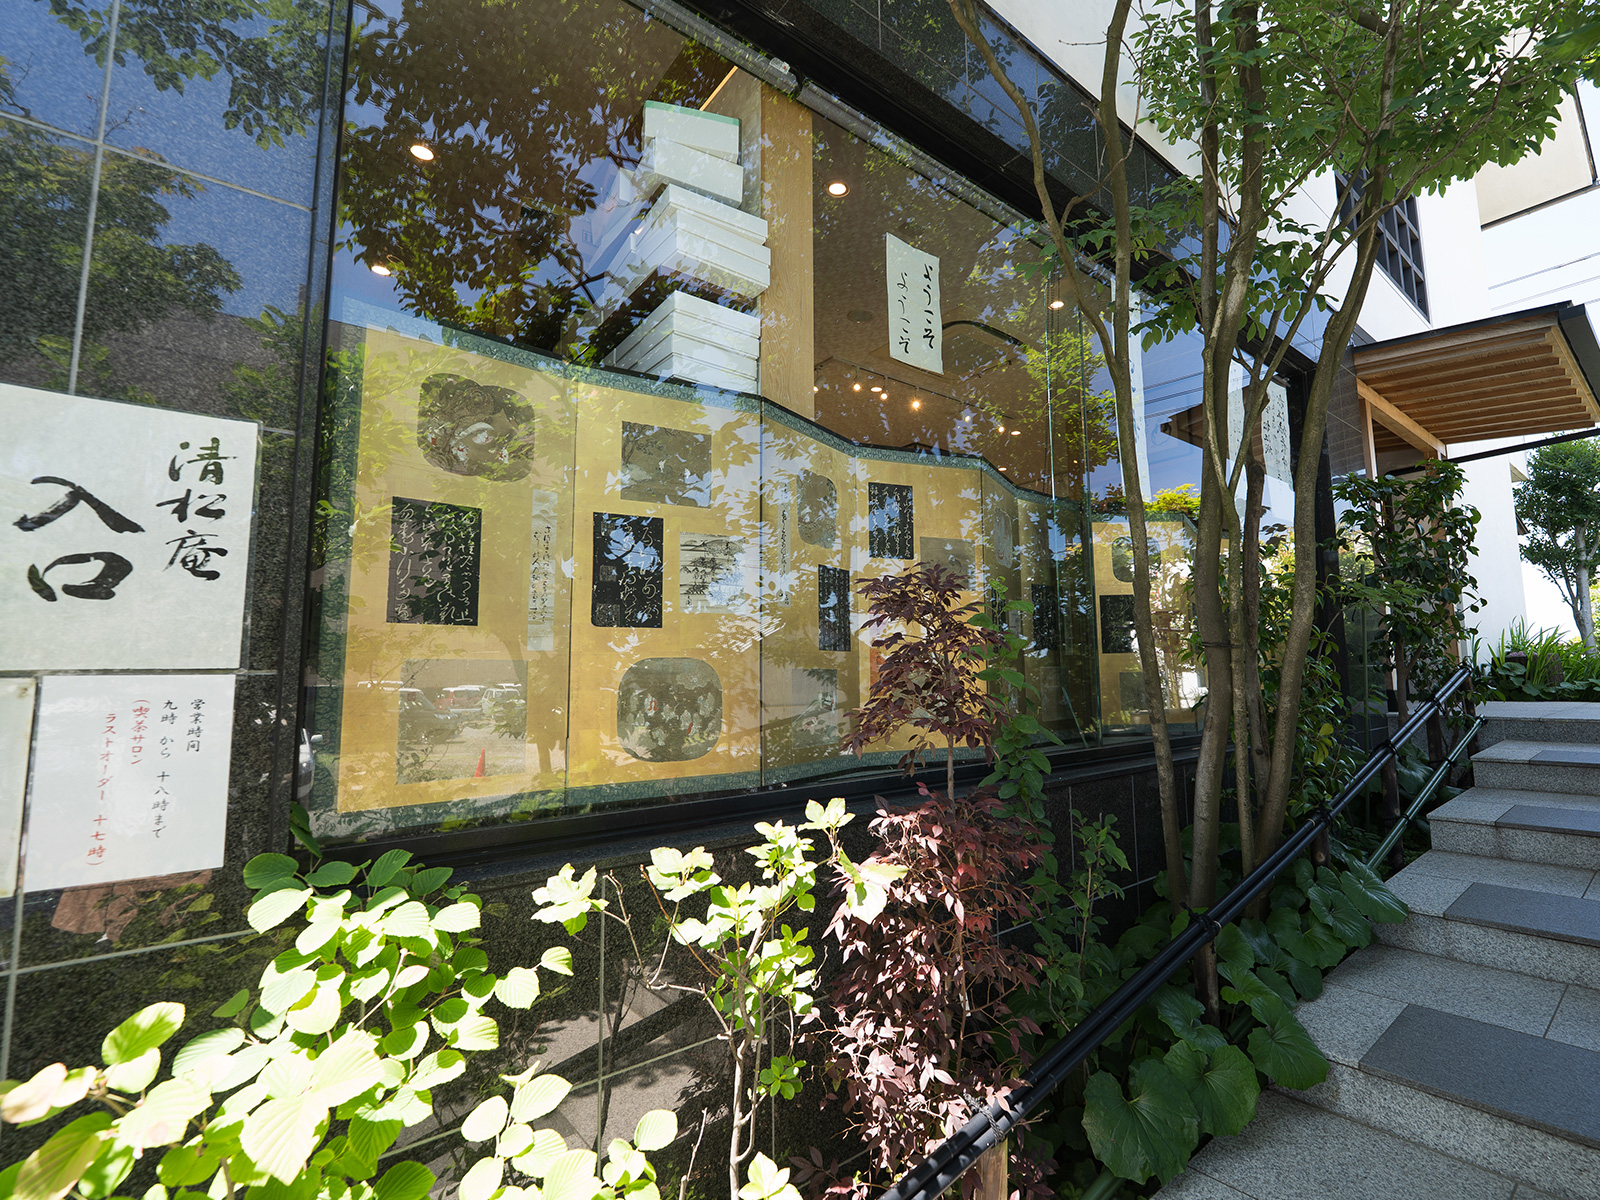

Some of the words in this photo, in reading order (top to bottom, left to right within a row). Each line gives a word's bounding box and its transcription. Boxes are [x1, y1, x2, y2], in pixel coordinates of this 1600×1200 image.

[896, 272, 911, 354] ようこそ
[922, 263, 935, 349] ようこそ
[12, 475, 146, 602] 入口
[156, 436, 239, 581] 清松庵
[159, 735, 175, 760] から
[160, 699, 178, 726] 九時
[186, 698, 206, 753] 営業時間
[96, 713, 117, 801] ラストオーダー
[151, 770, 171, 839] 十八時まで
